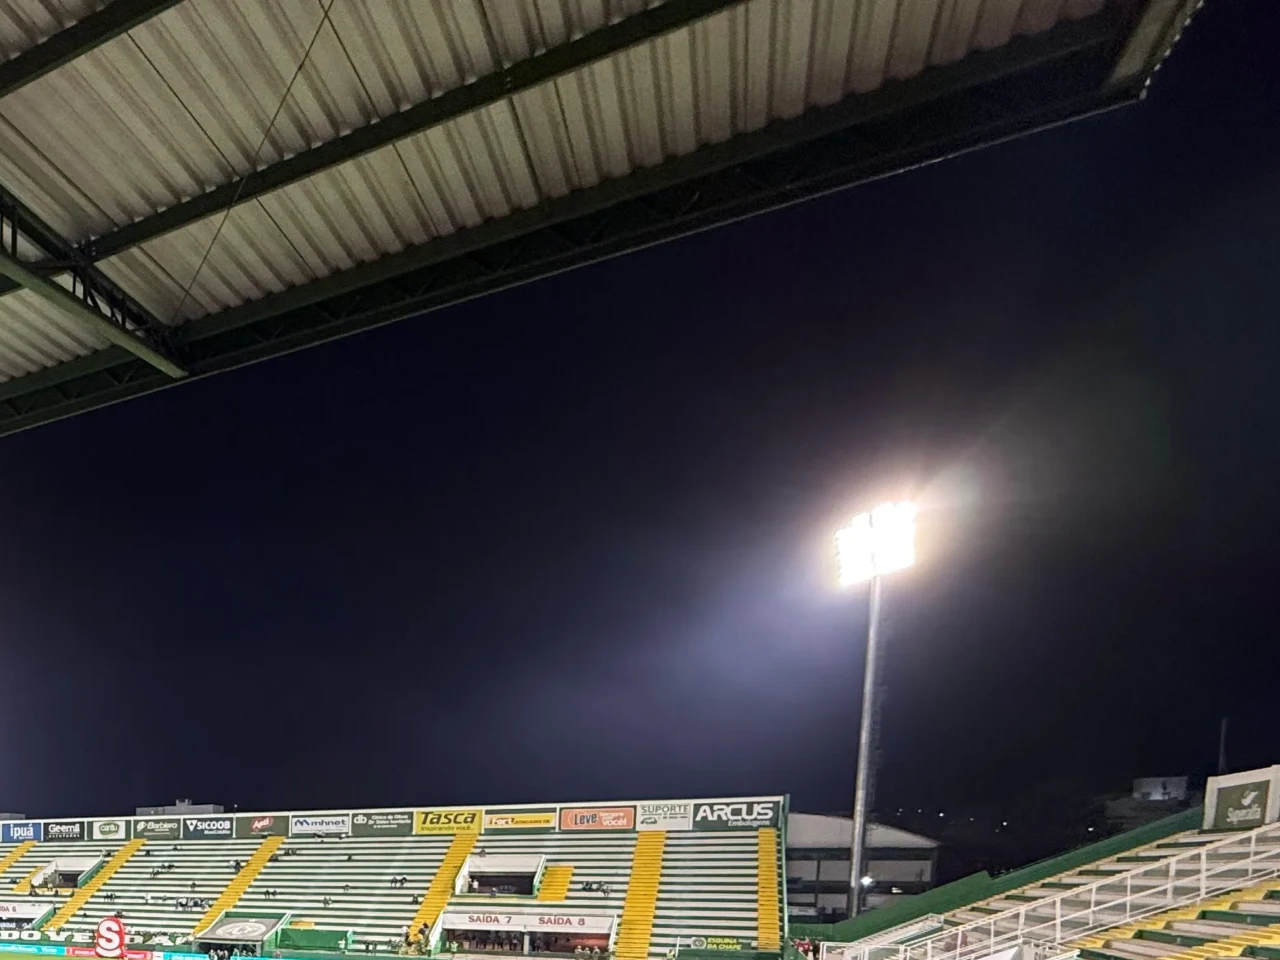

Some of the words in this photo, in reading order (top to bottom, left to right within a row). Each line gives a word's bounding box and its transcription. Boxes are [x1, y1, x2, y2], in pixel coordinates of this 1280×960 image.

[641, 804, 689, 814] SUPORTE
[695, 803, 773, 821] ARCUS
[421, 811, 477, 825] Tasca
[575, 813, 597, 825] Leve
[728, 819, 770, 828] Embalagens
[10, 824, 34, 839] ipuá
[197, 821, 231, 830] SICOOB
[468, 913, 500, 924] SAÍDA
[504, 915, 512, 924] 7
[538, 914, 573, 926] SAÍDA
[578, 917, 586, 926] 8
[98, 919, 121, 951] S
